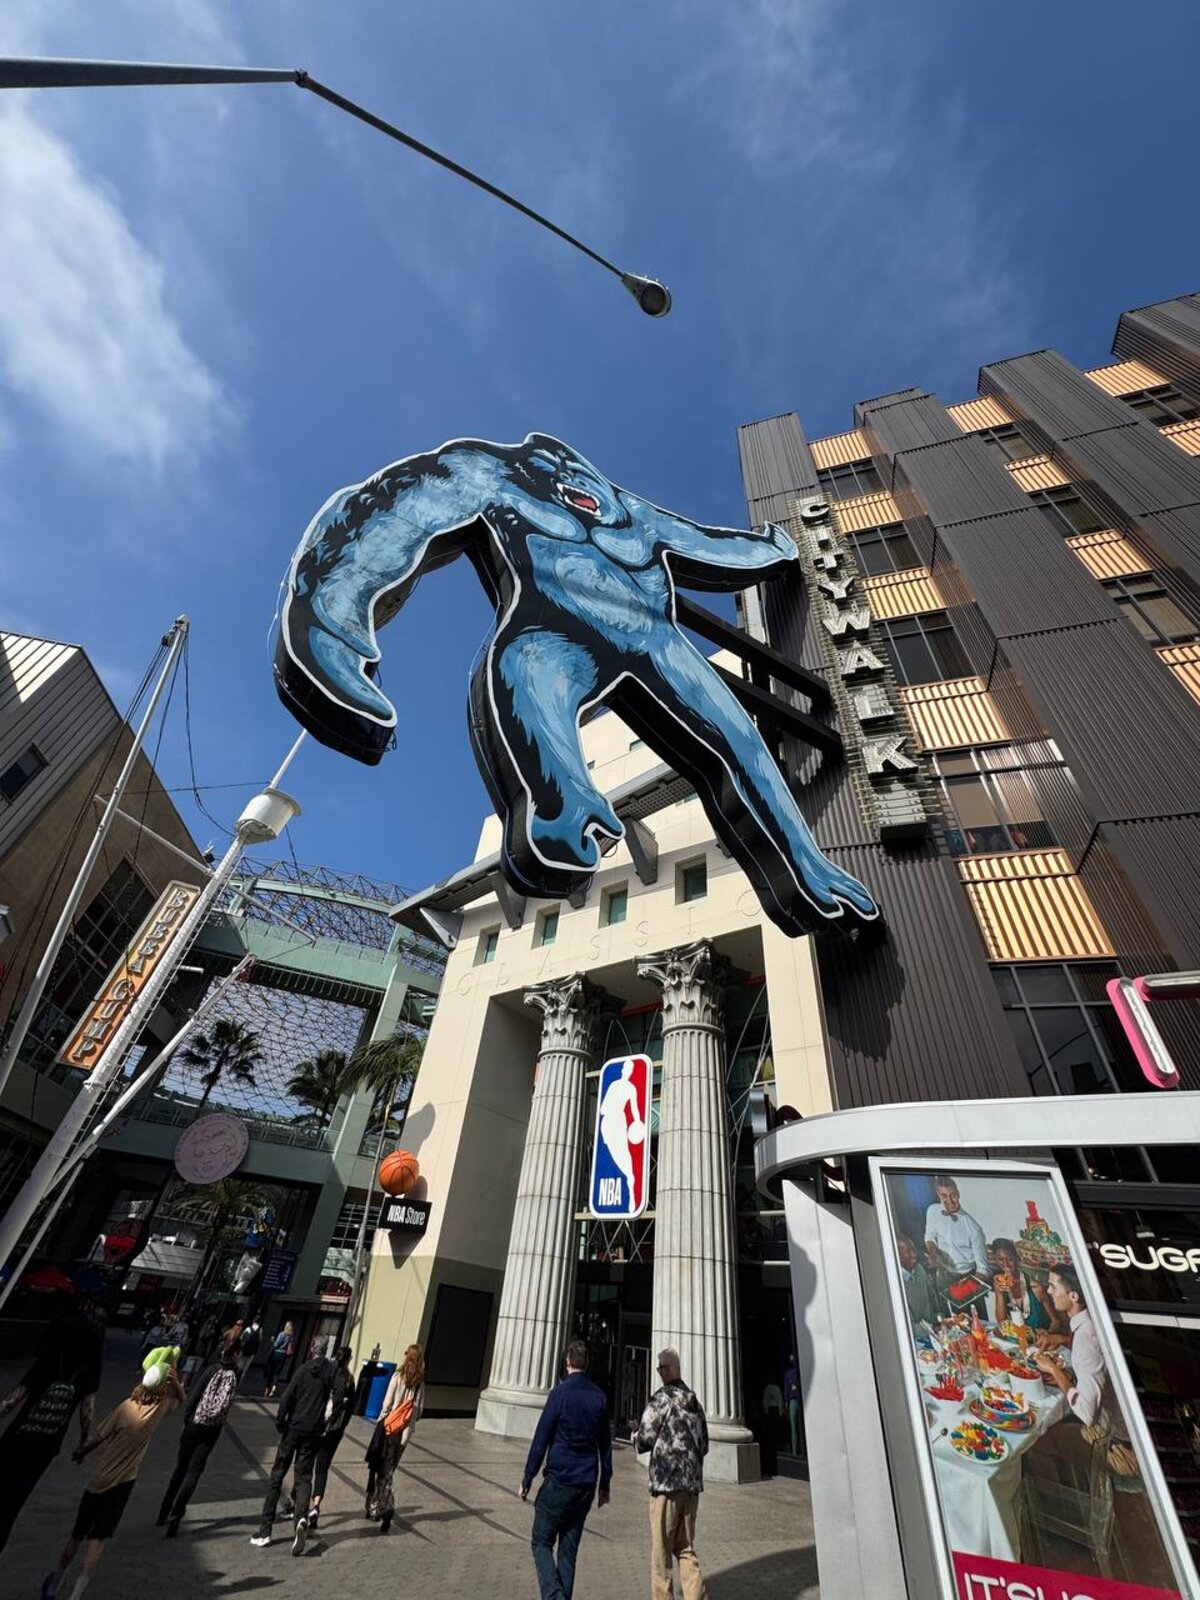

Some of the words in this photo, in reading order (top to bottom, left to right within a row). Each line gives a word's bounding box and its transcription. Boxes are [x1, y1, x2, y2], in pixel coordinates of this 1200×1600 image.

[800, 496, 920, 777] CITYWALK
[126, 888, 187, 975] BUBBA
[72, 979, 136, 1059] GUMP
[387, 1205, 406, 1223] NBA
[405, 1207, 426, 1226] Store
[598, 1177, 622, 1206] NBA
